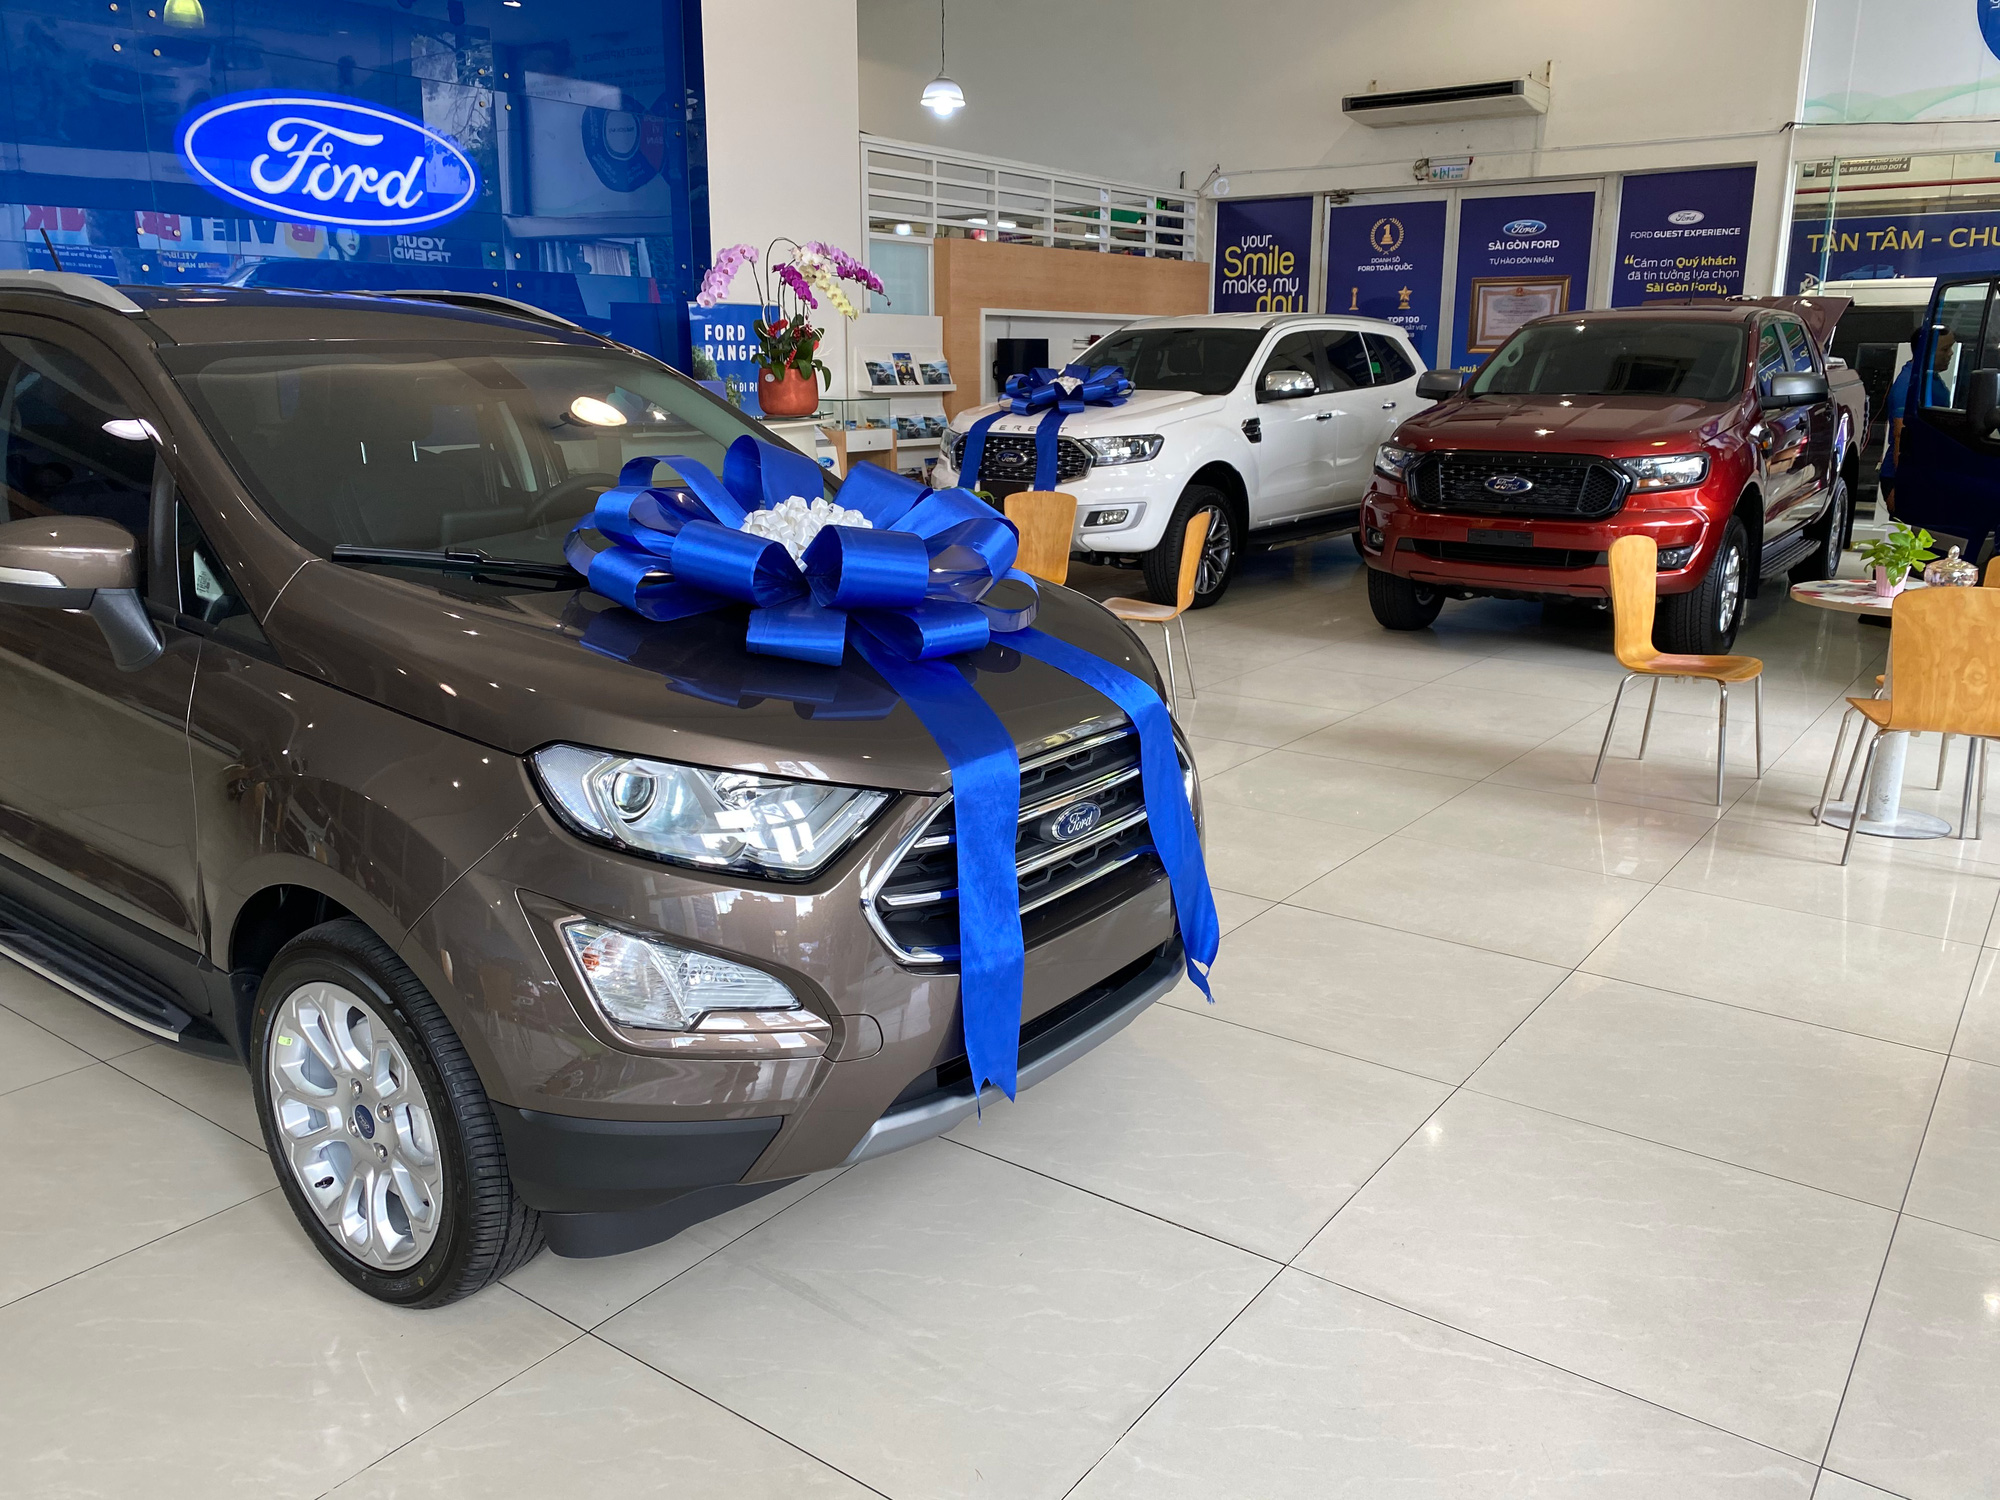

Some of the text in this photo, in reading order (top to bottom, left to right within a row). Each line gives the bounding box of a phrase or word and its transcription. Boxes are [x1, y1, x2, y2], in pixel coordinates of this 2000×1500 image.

[250, 116, 426, 210] Ford
[1821, 166, 1849, 175] CASOL
[1849, 165, 1870, 173] BRAKE
[1870, 164, 1888, 172] FLUID
[1888, 163, 1902, 171] DOT
[1676, 212, 1697, 222] Ford
[1511, 222, 1538, 234] Ford
[1630, 227, 1741, 239] FORD GUEST EXPERIENCE
[1241, 234, 1272, 252] your
[1866, 226, 1925, 251] TÂM
[1488, 239, 1560, 251] SÀI GÒN FORD
[1223, 244, 1295, 278] Smile
[1676, 255, 1699, 268] Quý
[1701, 255, 1736, 266] khách
[1627, 271, 1641, 280] đã
[1643, 271, 1657, 280] tin
[1712, 269, 1740, 280] chọn
[1222, 274, 1300, 297] make my
[1646, 282, 1664, 292] Sài
[1666, 282, 1689, 292] Gòn
[704, 324, 746, 341] FORD
[1493, 478, 1520, 490] Ford
[1067, 809, 1093, 834] Ford
